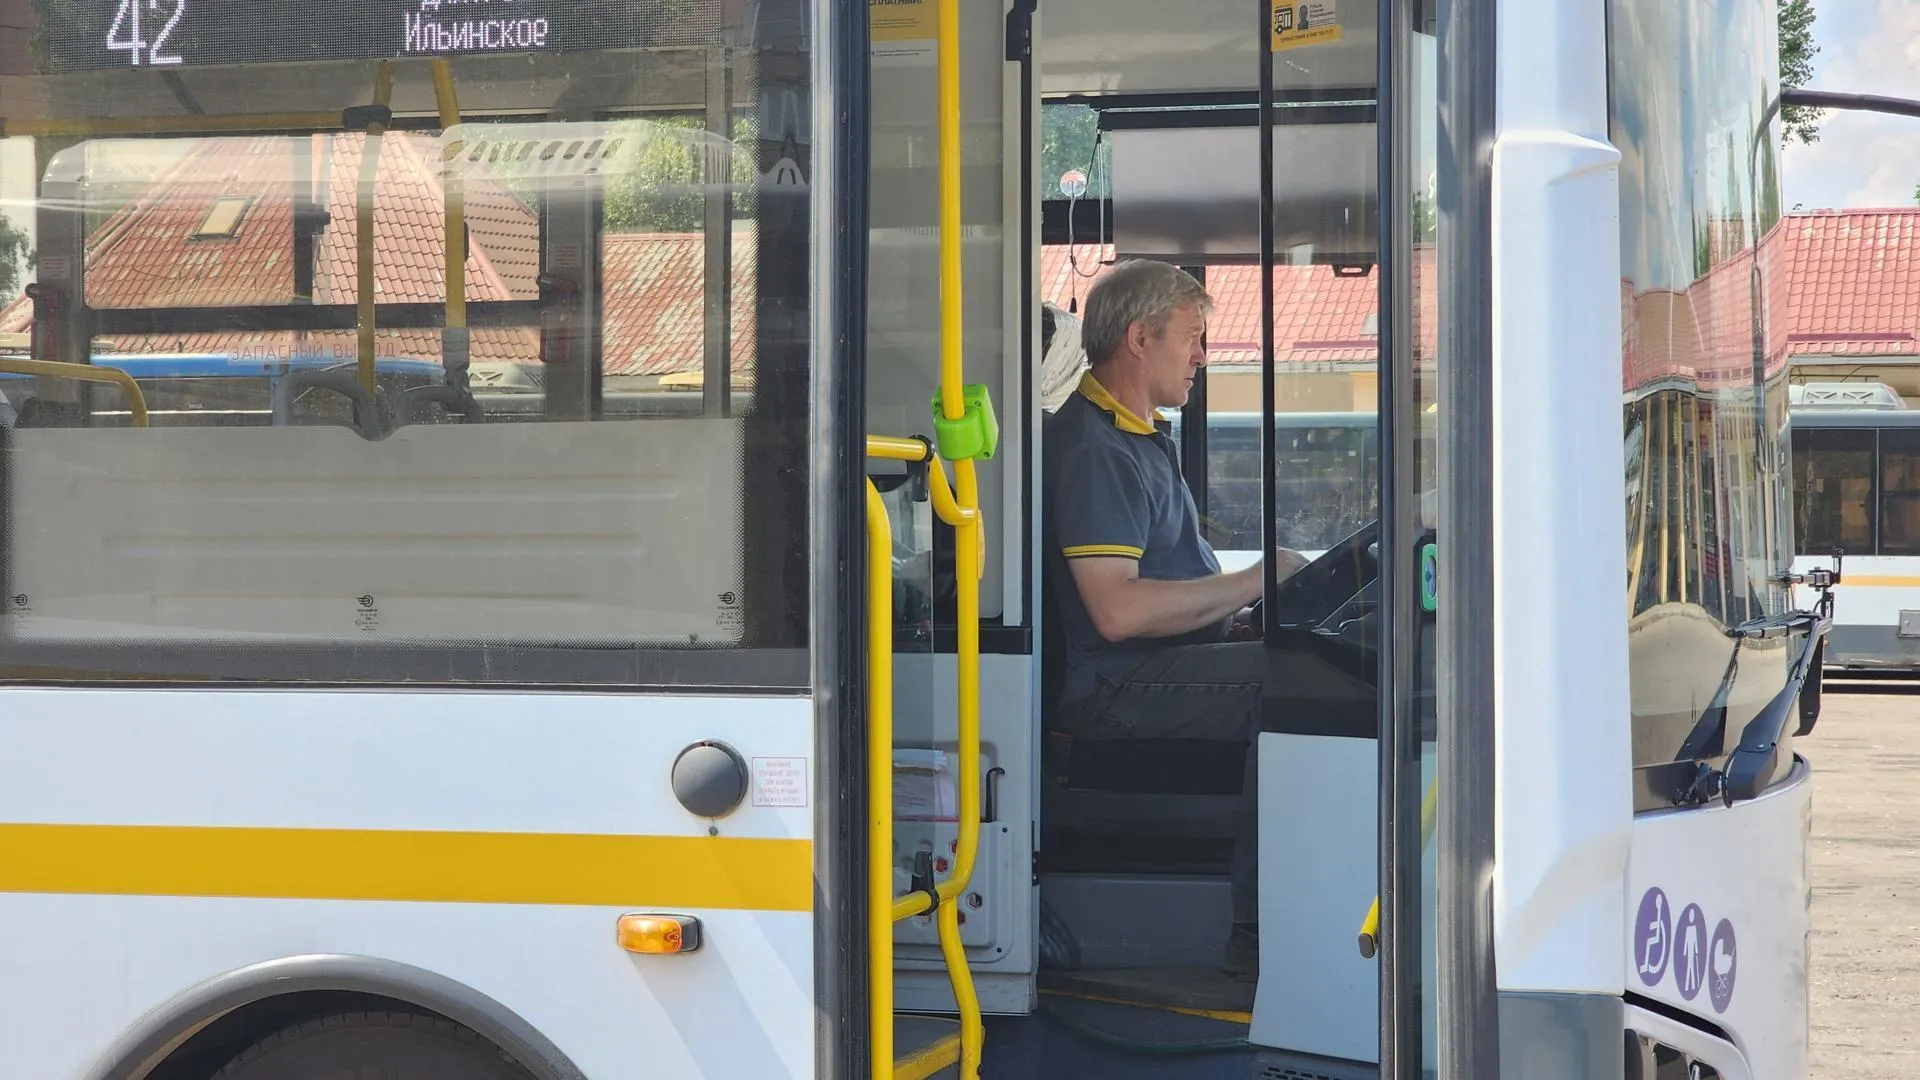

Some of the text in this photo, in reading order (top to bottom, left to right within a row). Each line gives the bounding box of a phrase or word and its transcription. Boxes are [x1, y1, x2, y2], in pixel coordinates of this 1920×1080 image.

[107, 0, 184, 64] 42
[405, 11, 548, 51] Ильинское
[231, 341, 396, 360] ЗАПАСНЫЙ ВЫОД
